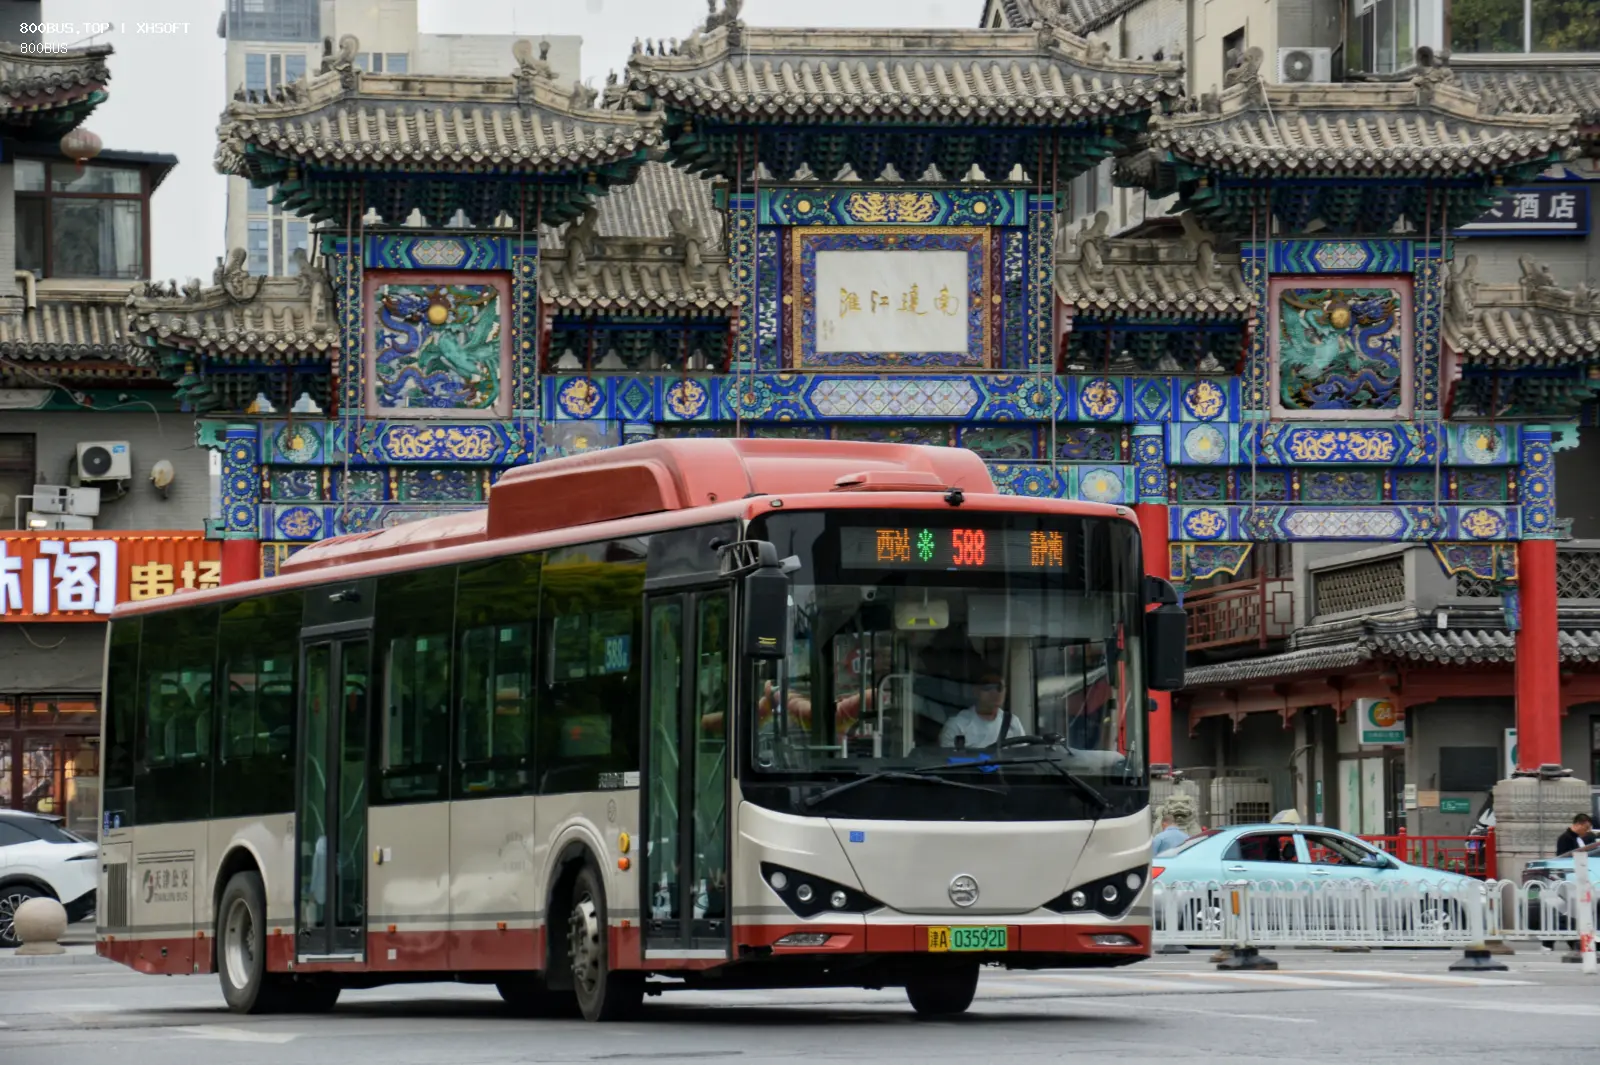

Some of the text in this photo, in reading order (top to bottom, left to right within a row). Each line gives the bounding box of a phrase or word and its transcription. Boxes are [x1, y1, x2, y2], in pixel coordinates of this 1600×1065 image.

[876, 528, 911, 562] 西站
[952, 528, 986, 566] 588
[154, 868, 189, 889] 天津公交
[954, 929, 1006, 948] 03592D
